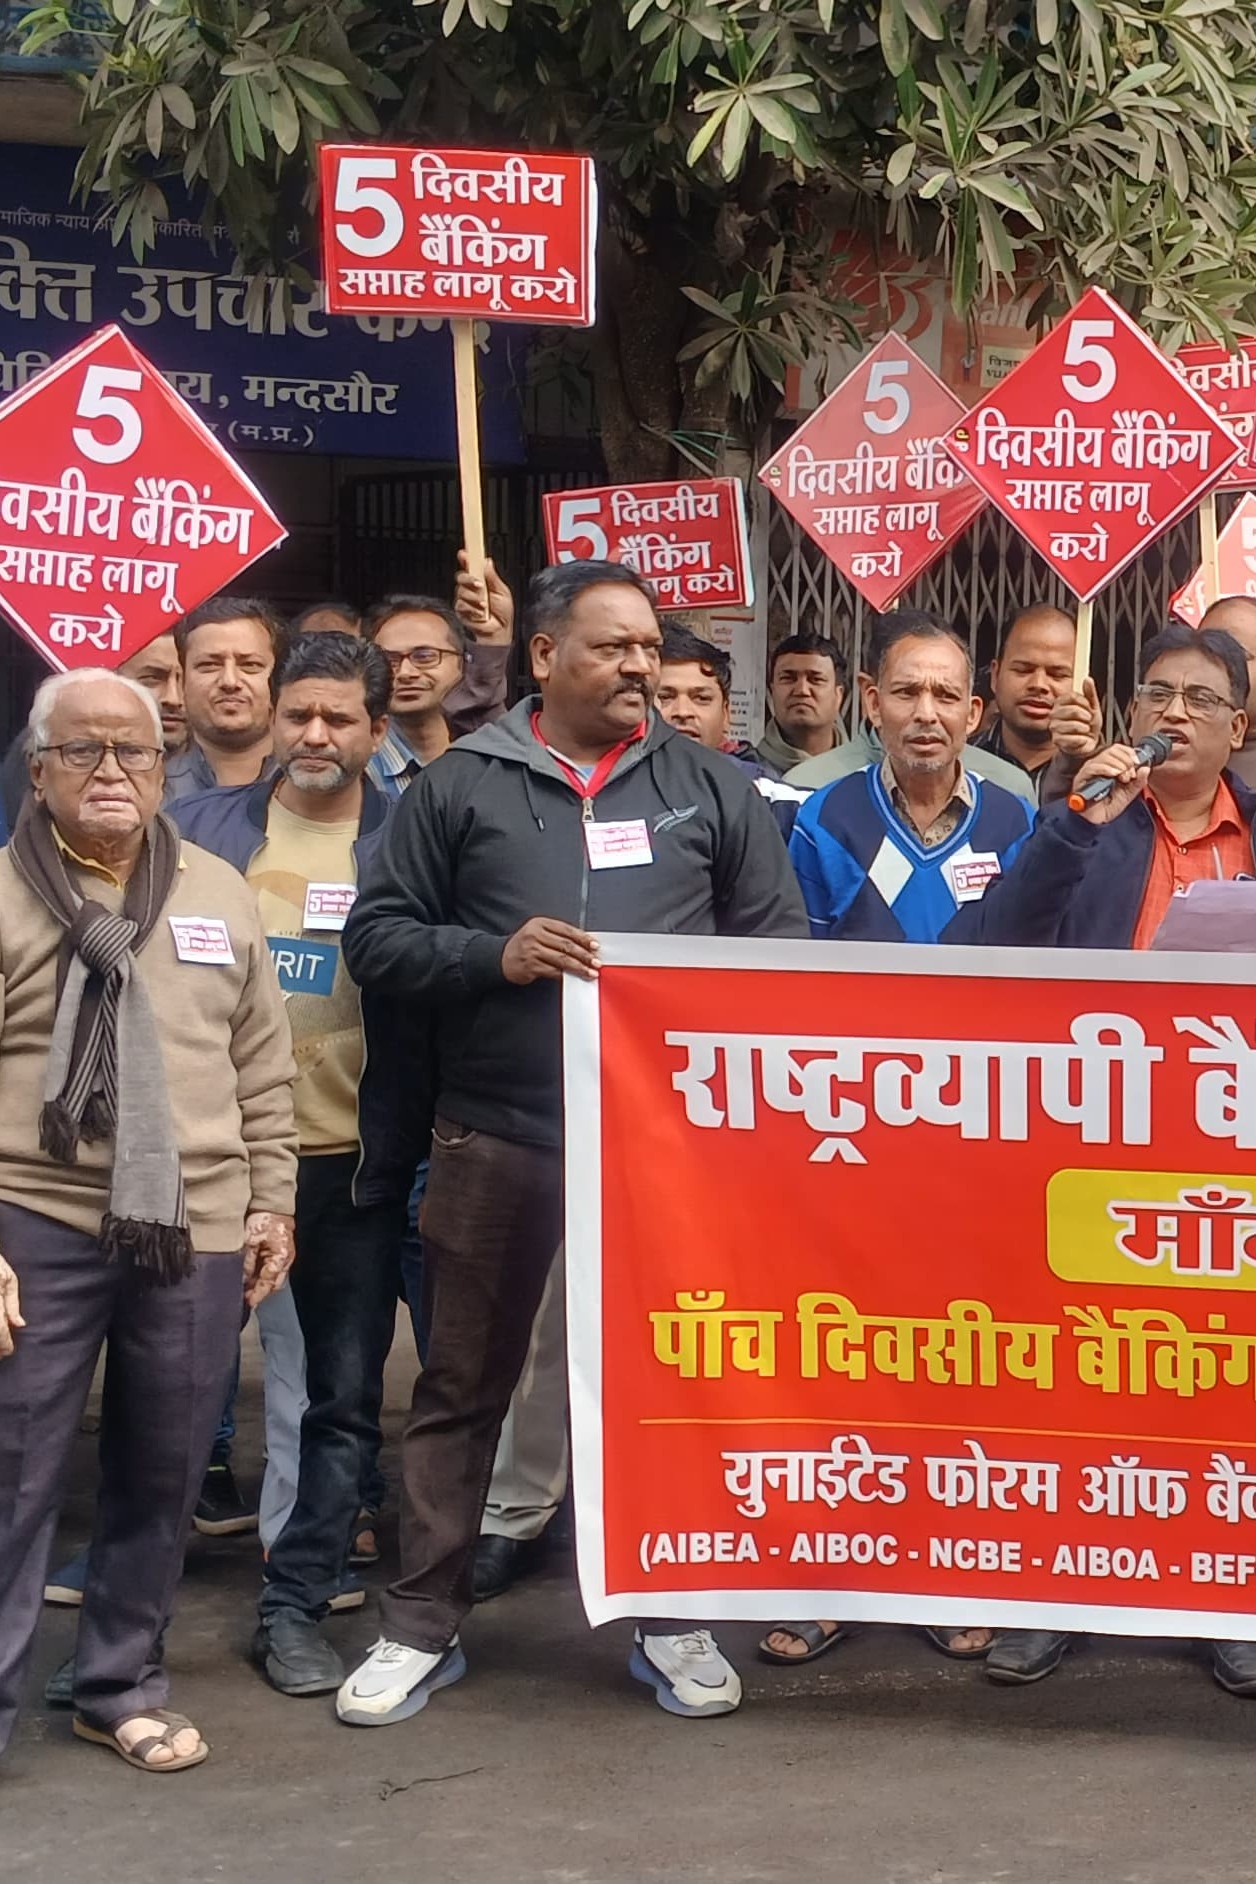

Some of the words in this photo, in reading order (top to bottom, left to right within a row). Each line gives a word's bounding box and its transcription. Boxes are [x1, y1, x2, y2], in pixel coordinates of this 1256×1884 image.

[334, 156, 403, 258] 5
[411, 152, 565, 207] दिवसीय
[419, 214, 549, 271] बैंकिंग
[117, 265, 329, 338] उपचार
[339, 267, 425, 299] सप्ताह
[433, 270, 511, 311] लागू
[511, 267, 579, 305] करो
[1061, 319, 1117, 402] 5
[72, 364, 143, 464] 5
[242, 370, 400, 415] मन्दसौर
[863, 360, 910, 434] 5
[975, 406, 1104, 471] दिवसीय
[1110, 409, 1212, 471] बैंकिंग
[787, 441, 900, 499] दिवसीय
[905, 437, 965, 491] बैंकि
[0, 467, 124, 540] वसीय
[131, 477, 254, 554] बैंकिंग
[557, 498, 608, 563] 5
[610, 485, 719, 527] दिवसीय
[813, 505, 881, 535] सप्ताह
[885, 502, 944, 541] लागू
[1005, 478, 1083, 514] सप्ताह
[1089, 481, 1156, 527] लागू
[851, 540, 903, 578] करो
[1050, 522, 1109, 562] करो
[102, 556, 185, 614] लागू
[686, 564, 735, 594] करो
[49, 603, 125, 651] करो
[664, 1012, 1164, 1164] राष्ट्रव्यापी
[649, 1290, 783, 1380] पाँच
[797, 1291, 1060, 1390] दिवसीय
[924, 1439, 1060, 1514] फोरम
[1078, 1455, 1190, 1519] ऑफ
[638, 1531, 759, 1574] (AIBEA
[789, 1533, 899, 1567] AIBOC
[929, 1536, 1022, 1574] NCBE
[1051, 1541, 1161, 1581] AIBOA
